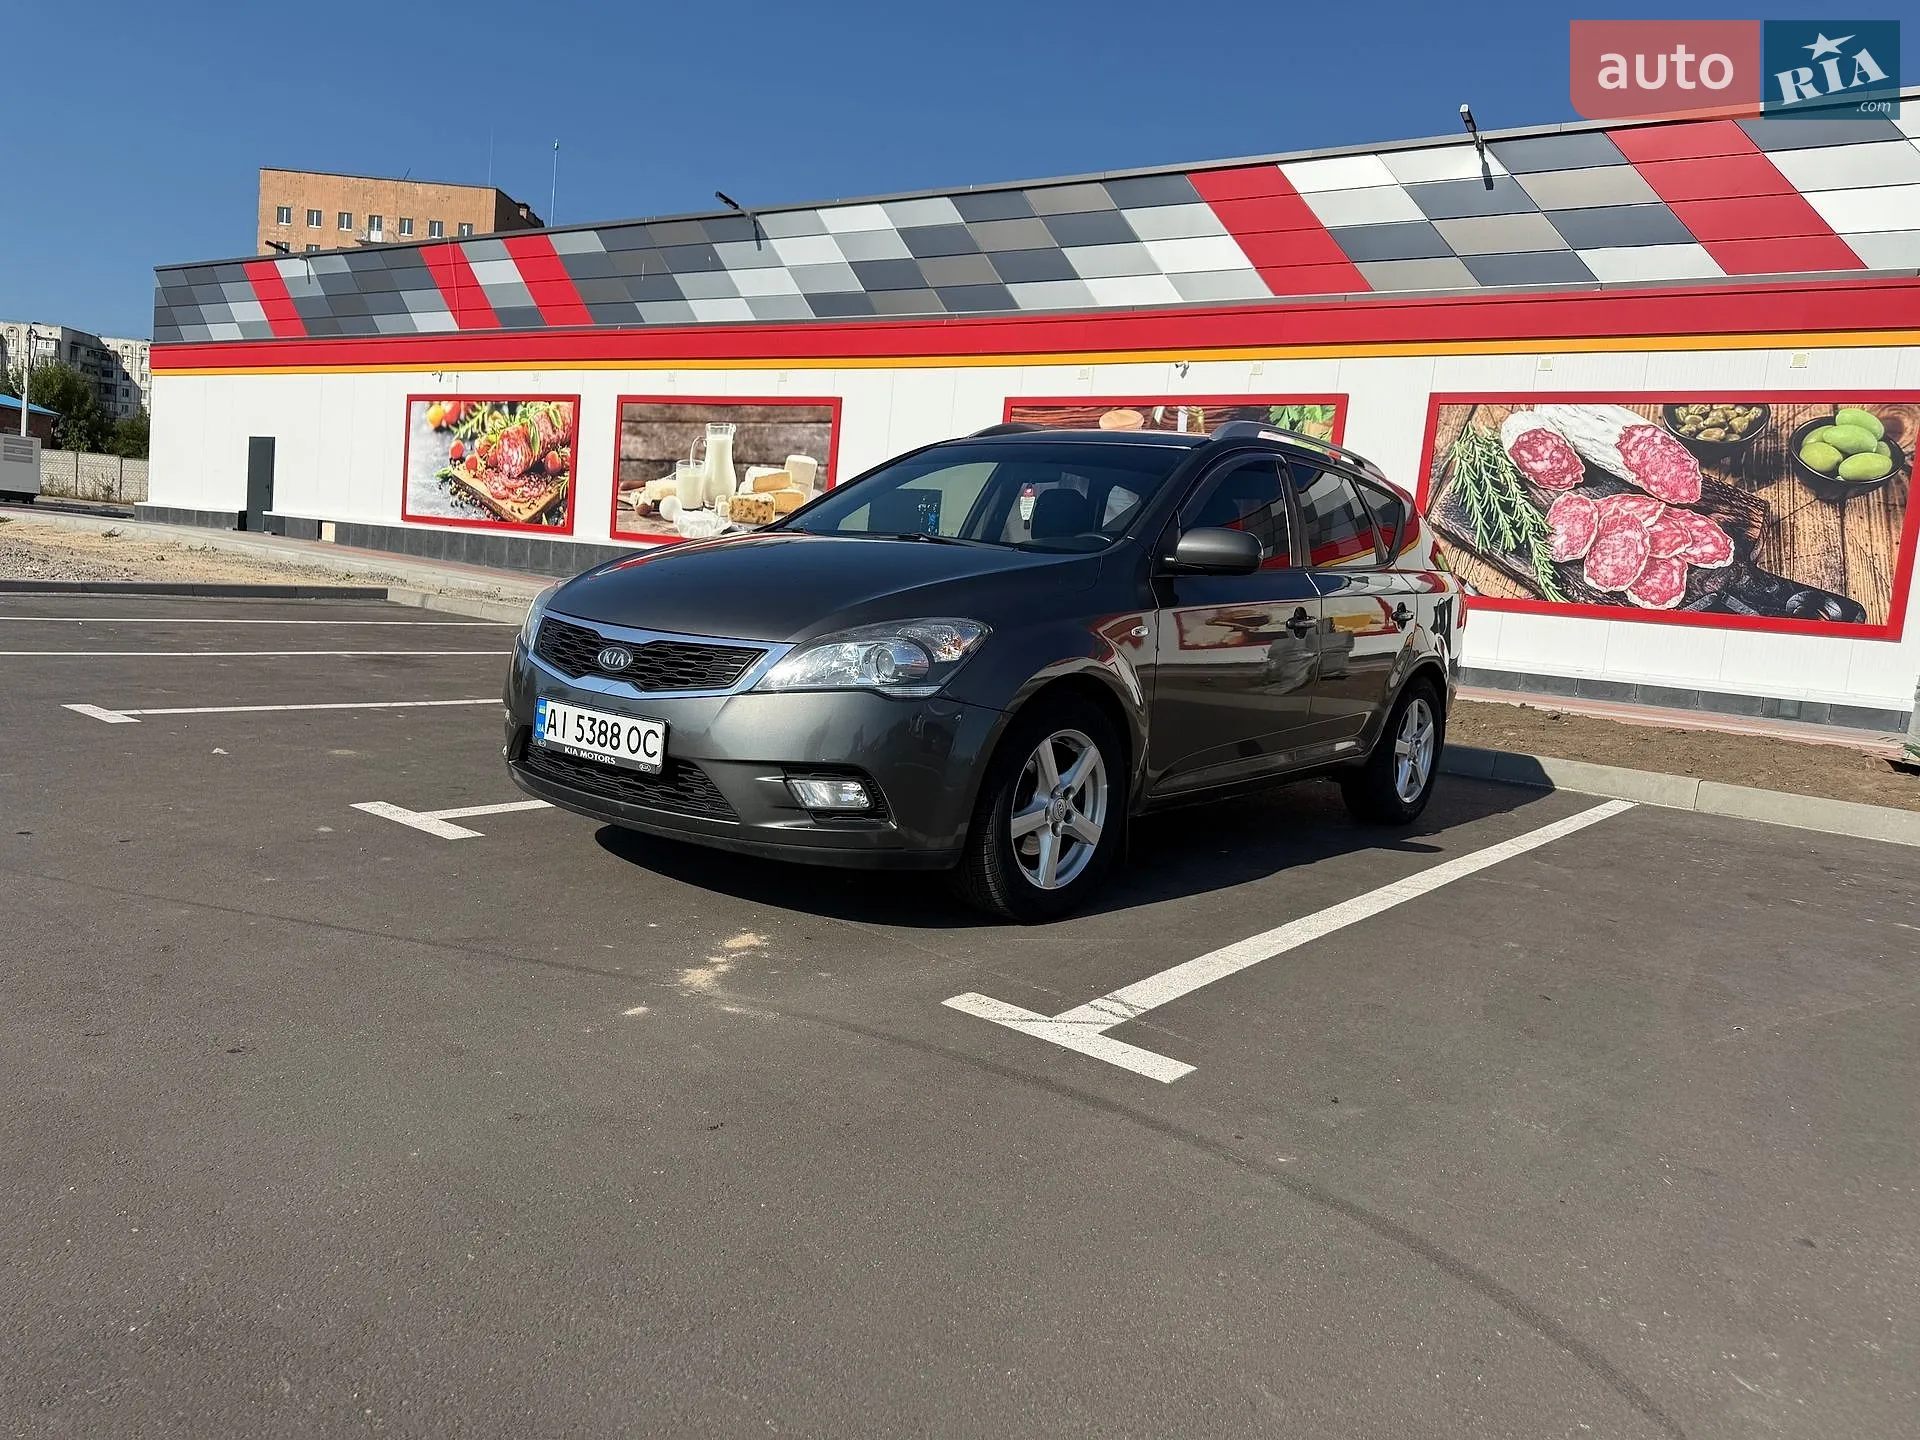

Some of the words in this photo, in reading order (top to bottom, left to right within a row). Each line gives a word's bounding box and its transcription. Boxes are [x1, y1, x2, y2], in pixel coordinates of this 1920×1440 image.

[602, 651, 625, 667] KIA
[546, 708, 567, 739] AI
[574, 714, 621, 751] 5388
[626, 725, 660, 758] OC
[564, 745, 579, 757] KIA
[579, 749, 617, 765] MOTORS
